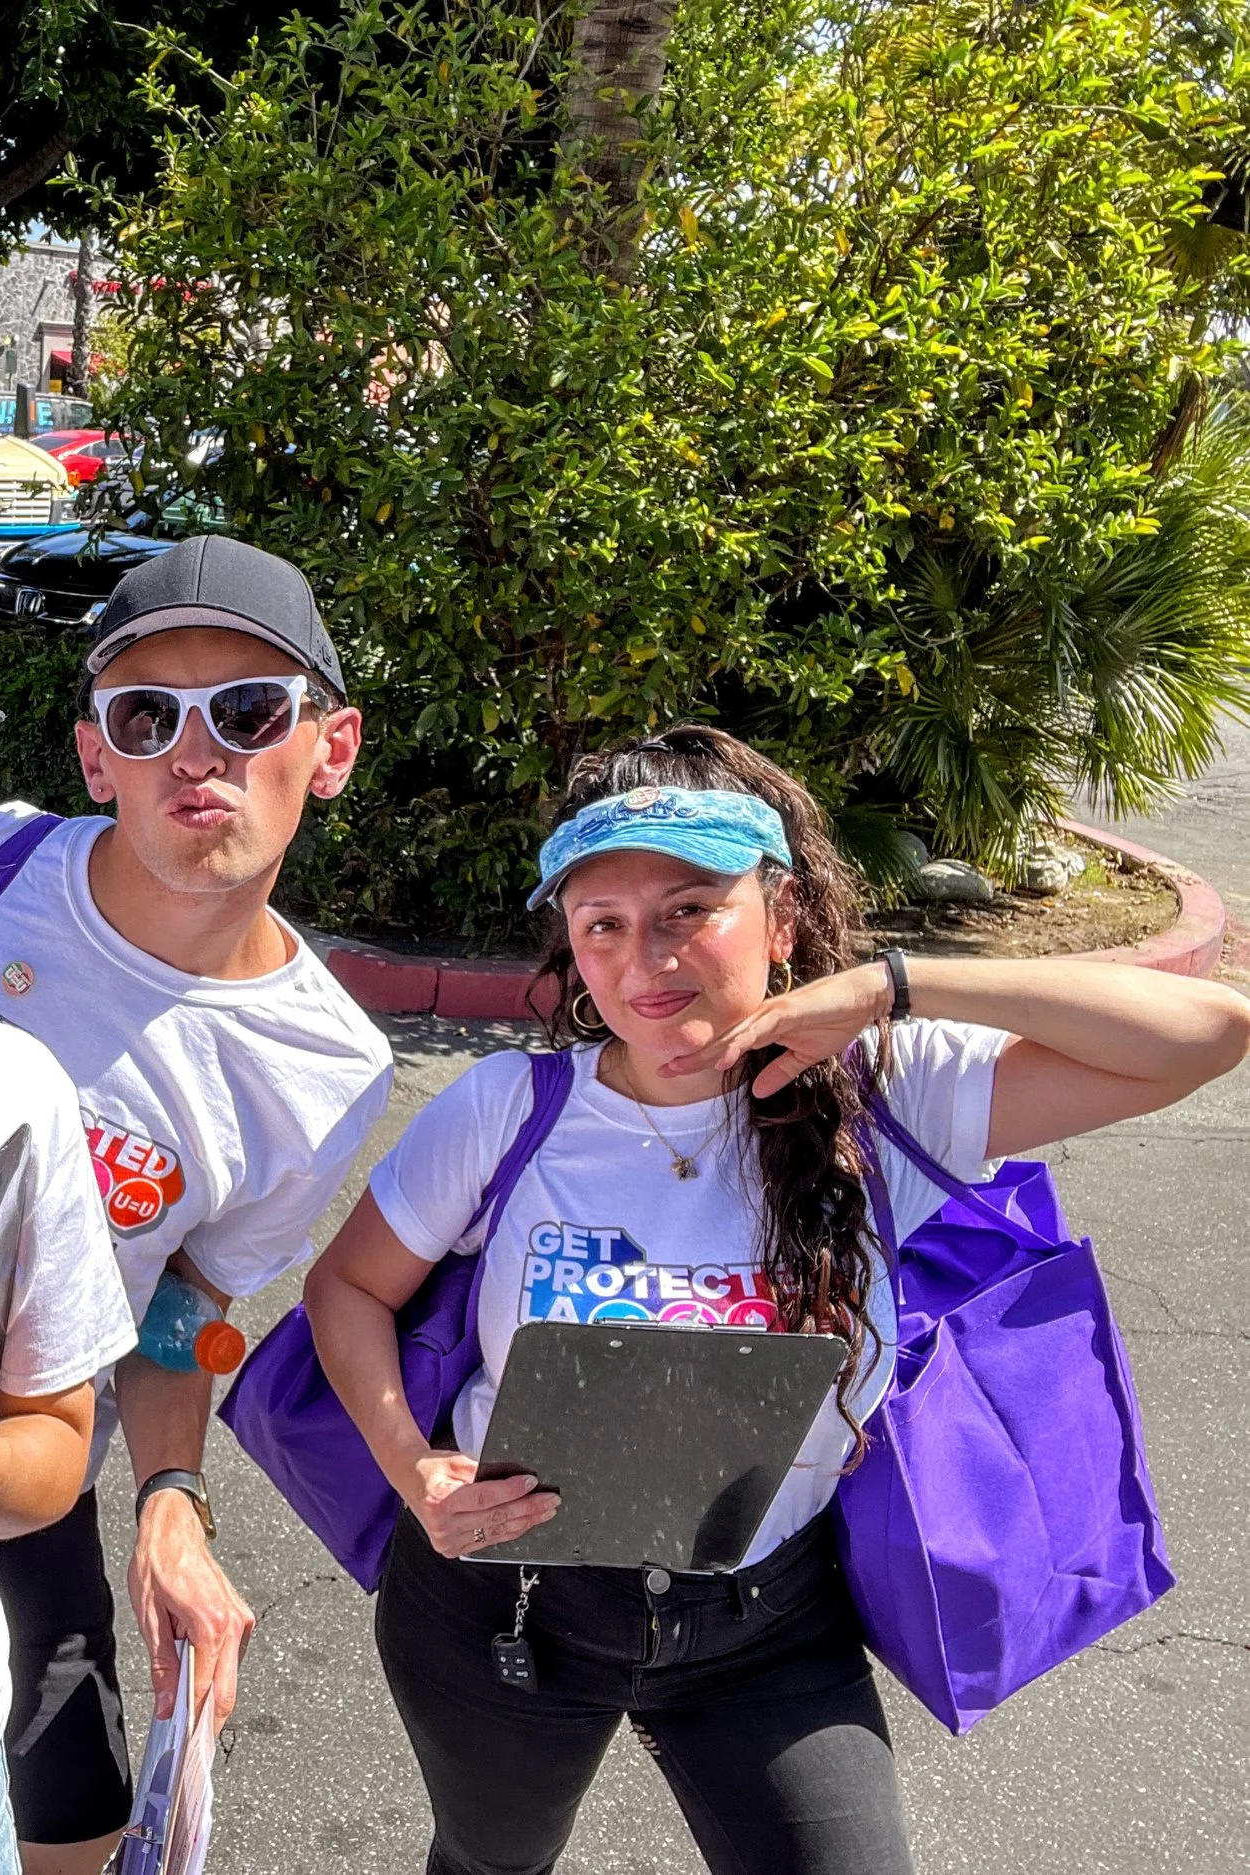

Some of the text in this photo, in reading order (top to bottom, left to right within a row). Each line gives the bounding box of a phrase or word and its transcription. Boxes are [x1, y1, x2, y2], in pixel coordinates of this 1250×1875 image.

[114, 1191, 155, 1218] U=U
[530, 1224, 621, 1262] GET
[520, 1290, 580, 1323] LA
